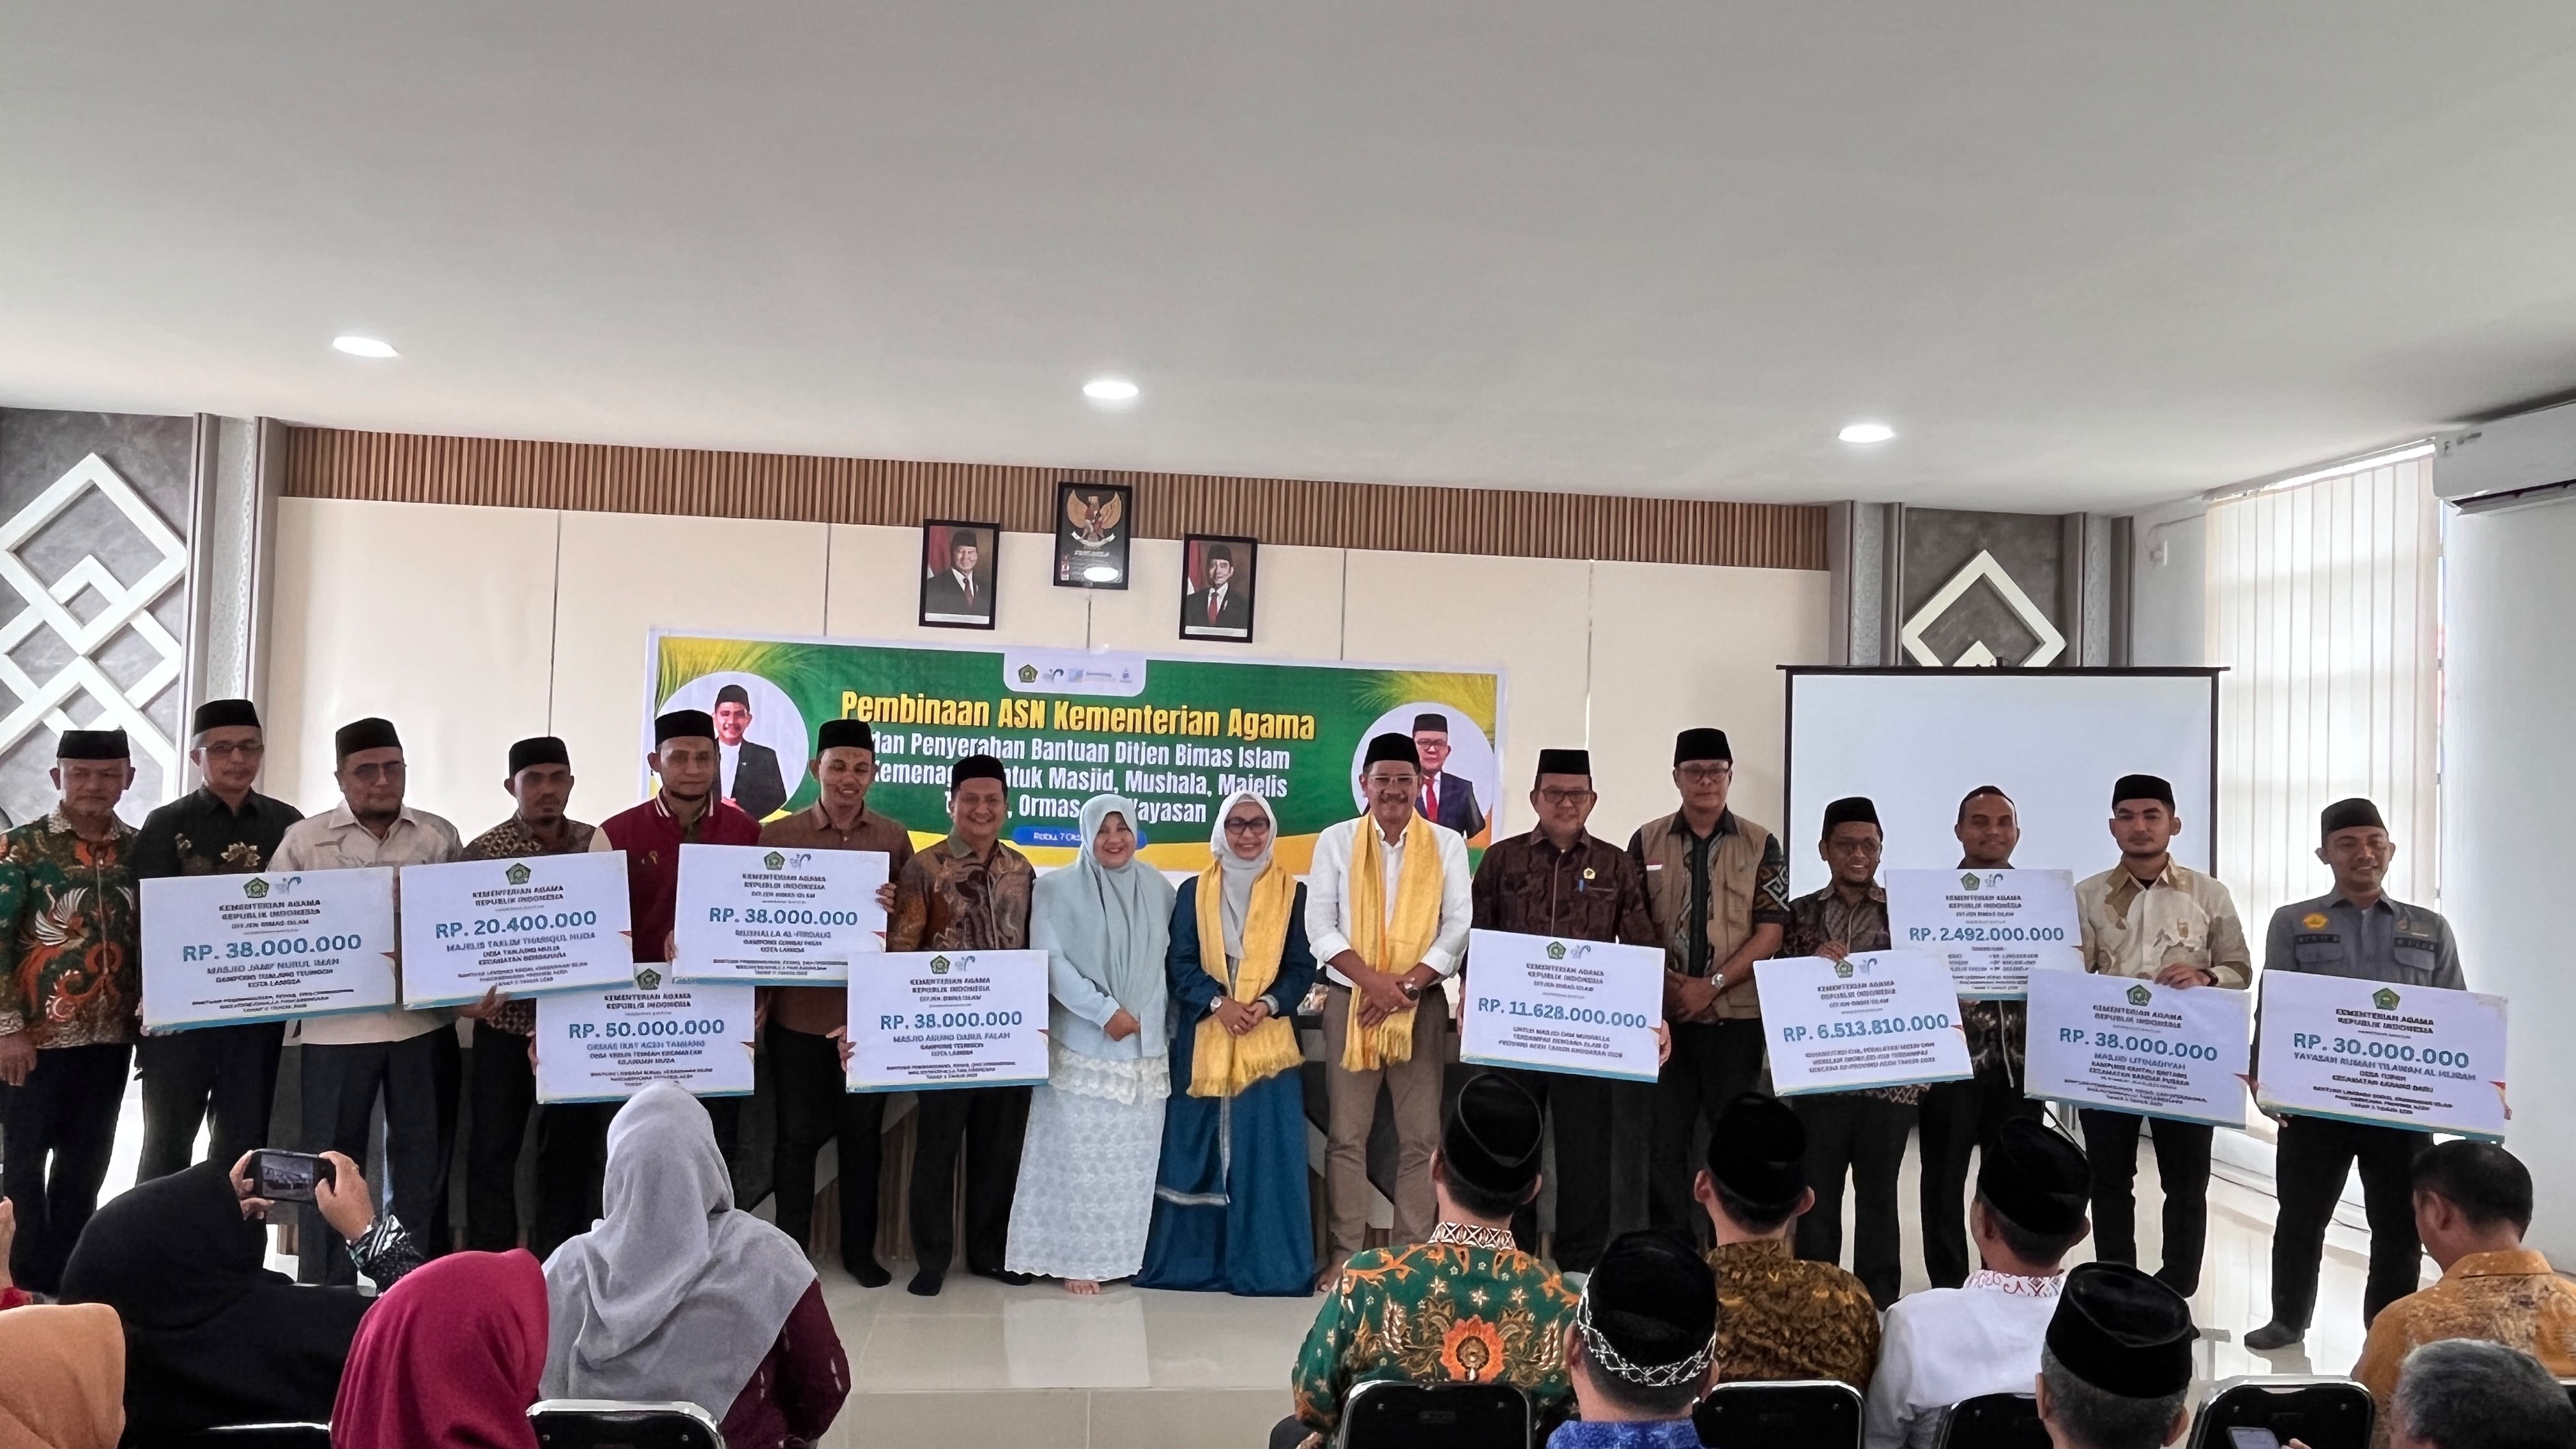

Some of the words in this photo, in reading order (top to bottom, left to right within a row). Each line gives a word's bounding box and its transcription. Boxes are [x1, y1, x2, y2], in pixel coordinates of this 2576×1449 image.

[841, 691, 990, 727] Pembinaan
[998, 698, 1045, 729] ASN
[1054, 699, 1219, 737] Kementerian
[1227, 708, 1315, 740] Agama
[911, 733, 1025, 760] Penyerahan
[1031, 738, 1109, 763] Bantuan
[1115, 741, 1169, 766] Ditjen
[1176, 744, 1232, 767] Bimas
[1239, 746, 1289, 769] Islam
[1004, 766, 1043, 788] ntuk
[1049, 767, 1119, 794] Masjid,
[1125, 770, 1212, 797] Mushala,
[1218, 774, 1287, 797] Majelis
[1133, 799, 1206, 824] ayasan
[436, 922, 468, 939] RP.
[475, 910, 596, 935] 20.400.000
[710, 908, 739, 923] RP.
[746, 909, 857, 925] 38.000.000
[183, 945, 220, 962] RP.
[226, 935, 361, 958] 38.000.000
[1910, 928, 1936, 941] RP.
[881, 1015, 909, 1030] RP.
[915, 1011, 1022, 1029] 38.000.000
[1478, 998, 1503, 1013] RP.
[1509, 1001, 1646, 1028] 11.628.000.000
[569, 1023, 600, 1038] RP.
[606, 1020, 724, 1037] 50.000.000
[1784, 1026, 1813, 1042] RP.
[1818, 1014, 1949, 1038] 6.513.810.000
[2060, 1028, 2089, 1045] RP.
[2095, 1032, 2217, 1061] 38.000.000
[2294, 1033, 2327, 1050] RP.
[2333, 1038, 2469, 1068] 30.000.000
